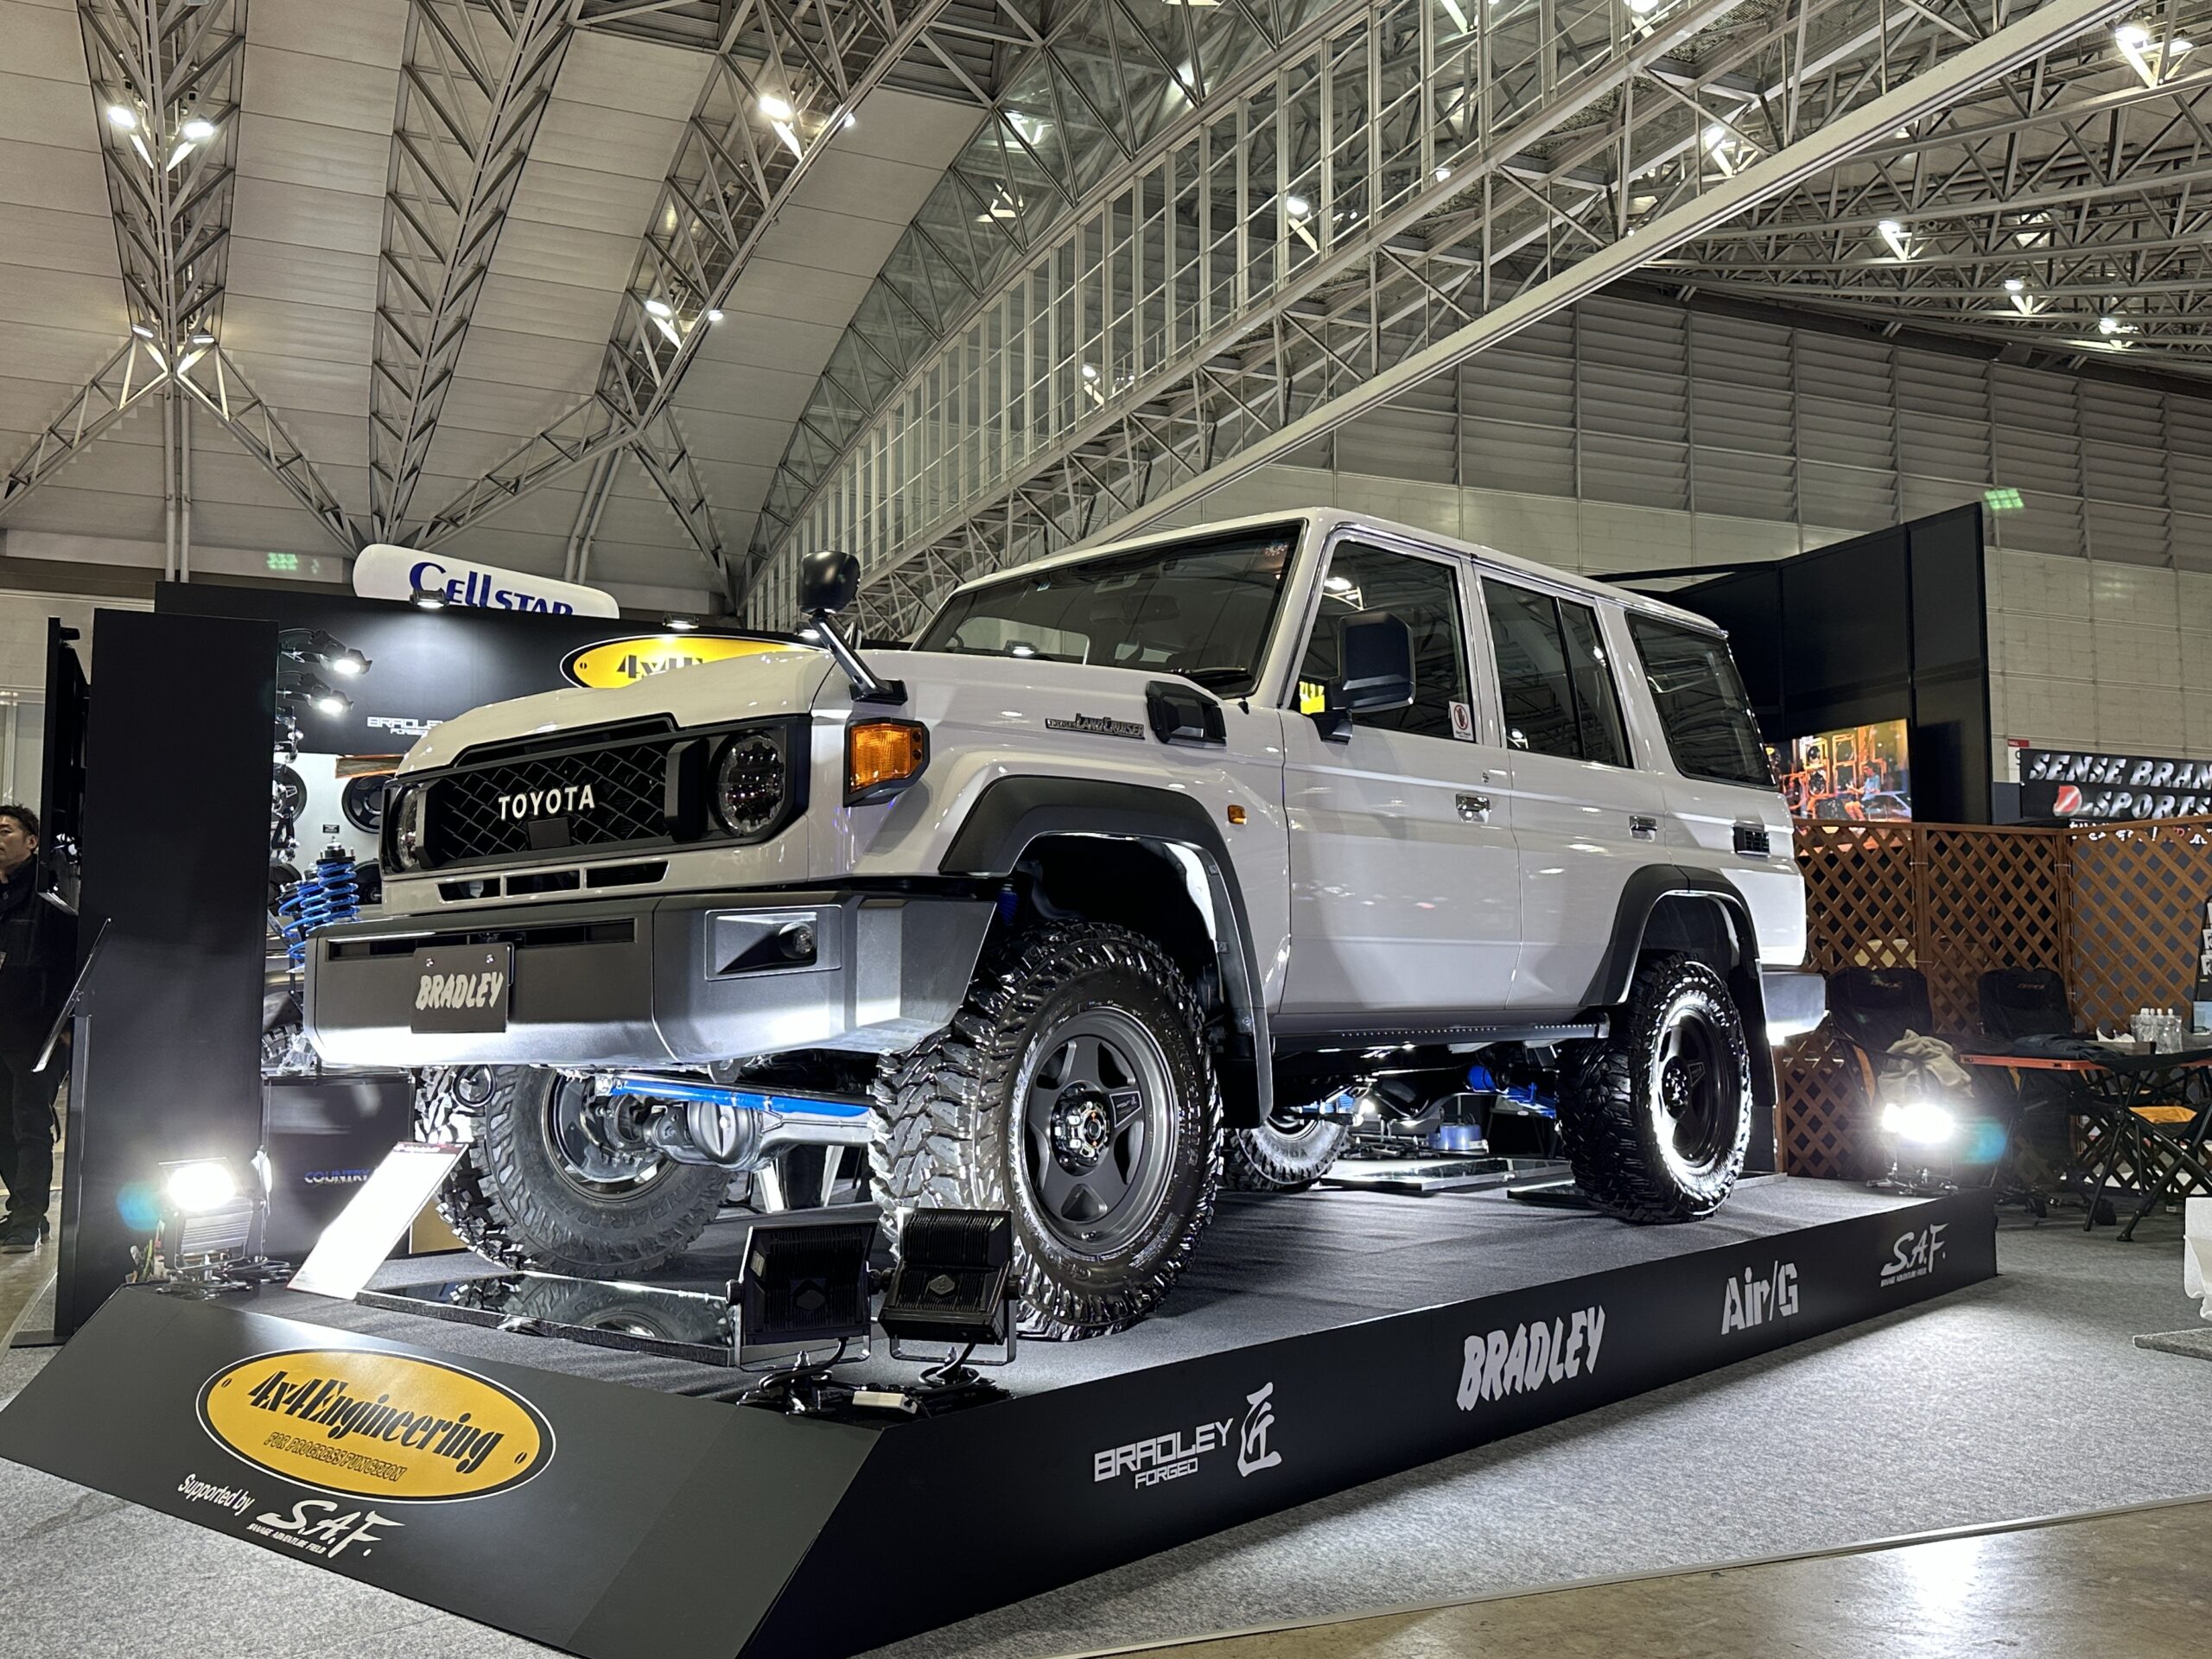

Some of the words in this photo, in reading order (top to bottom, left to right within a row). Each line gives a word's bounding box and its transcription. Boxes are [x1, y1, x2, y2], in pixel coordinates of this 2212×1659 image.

[367, 716, 443, 730] BRADLE
[2030, 753, 2126, 785] SENSE
[498, 784, 595, 820] TOYOTA
[415, 971, 504, 1011] BRADLEY
[1721, 1260, 1799, 1336] Air/G
[1456, 1305, 1605, 1412] BRADLEY
[248, 1370, 505, 1474] 4x4Engineering
[1236, 1382, 1282, 1478] 匠
[264, 1431, 291, 1451] FOR
[284, 1437, 347, 1466] PROGRESS
[346, 1452, 408, 1483] FUNCTION
[1094, 1417, 1234, 1483] BRADLEY
[178, 1473, 243, 1508] Supported
[232, 1489, 256, 1516] by
[1135, 1457, 1198, 1490] FORGED
[271, 1530, 307, 1549] ADVENTURE
[305, 1541, 327, 1554] FIELD
